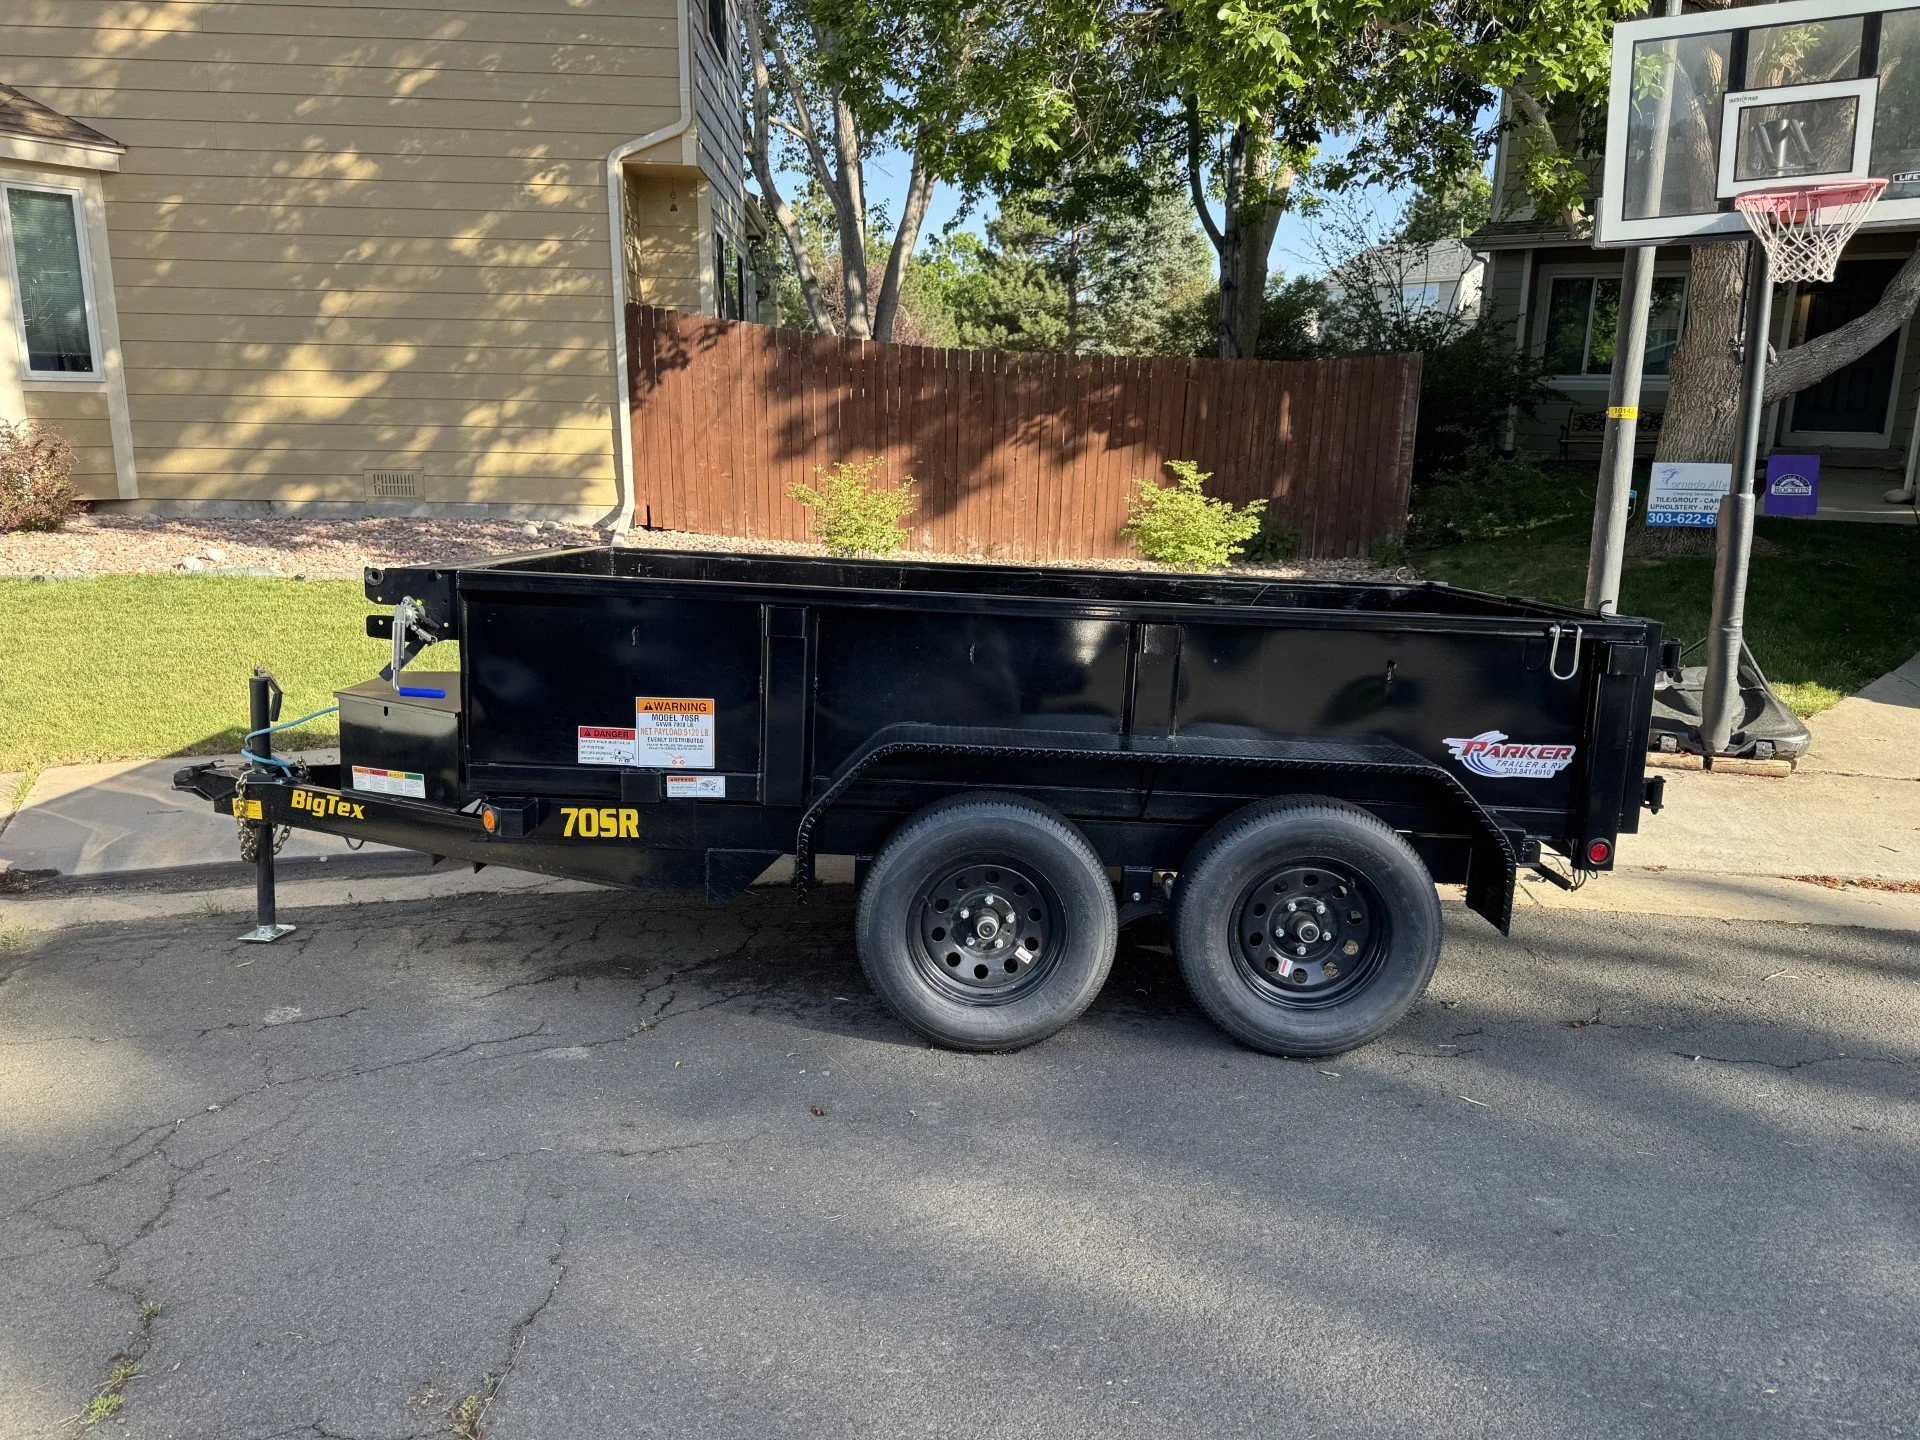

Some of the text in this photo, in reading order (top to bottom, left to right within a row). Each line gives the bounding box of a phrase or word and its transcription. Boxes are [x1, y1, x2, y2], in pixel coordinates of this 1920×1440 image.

[1707, 480, 1728, 490] Alle
[1648, 512, 1717, 524] 303-622-6
[653, 702, 707, 712] WARNING
[651, 714, 700, 722] MODEL 70SR
[593, 730, 629, 738] DANGER
[640, 727, 652, 735] NET
[654, 728, 682, 736] PAYLOAD
[1461, 741, 1573, 760] PARKER
[1504, 768, 1551, 776] 303.841.4910
[291, 789, 365, 820] BigTex
[561, 808, 640, 838] 70SR
